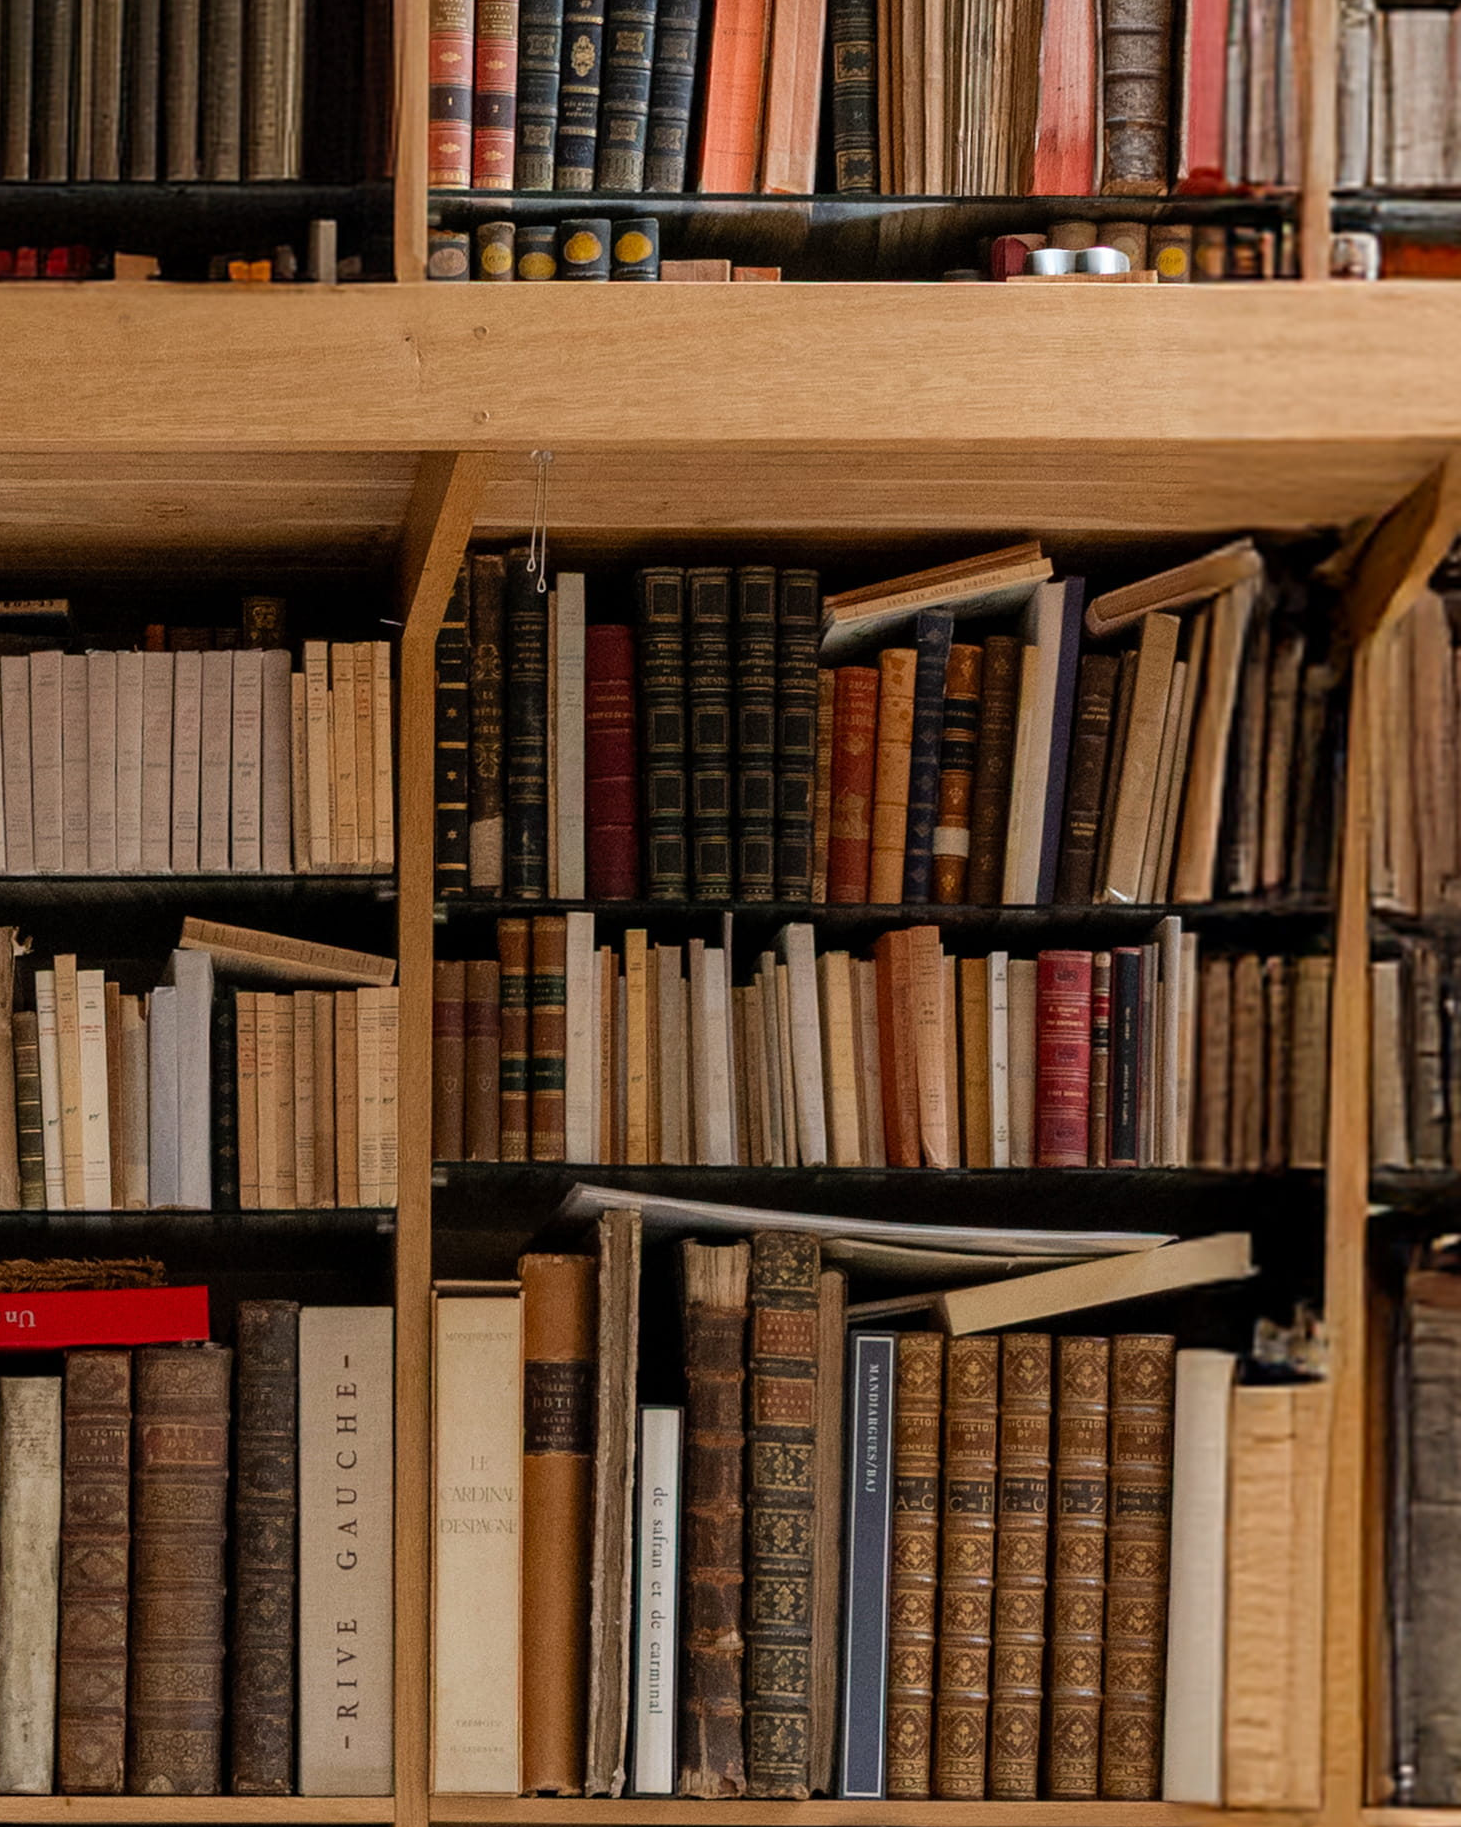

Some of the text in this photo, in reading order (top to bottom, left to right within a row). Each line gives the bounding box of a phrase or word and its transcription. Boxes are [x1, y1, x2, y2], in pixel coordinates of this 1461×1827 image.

[5, 1309, 37, 1328] Un
[865, 1363, 880, 1493] MANDIARGUES/BAJ
[471, 1456, 487, 1471] LE
[440, 1487, 518, 1502] CARDINAL
[648, 1487, 669, 1715] de safran et de carminal
